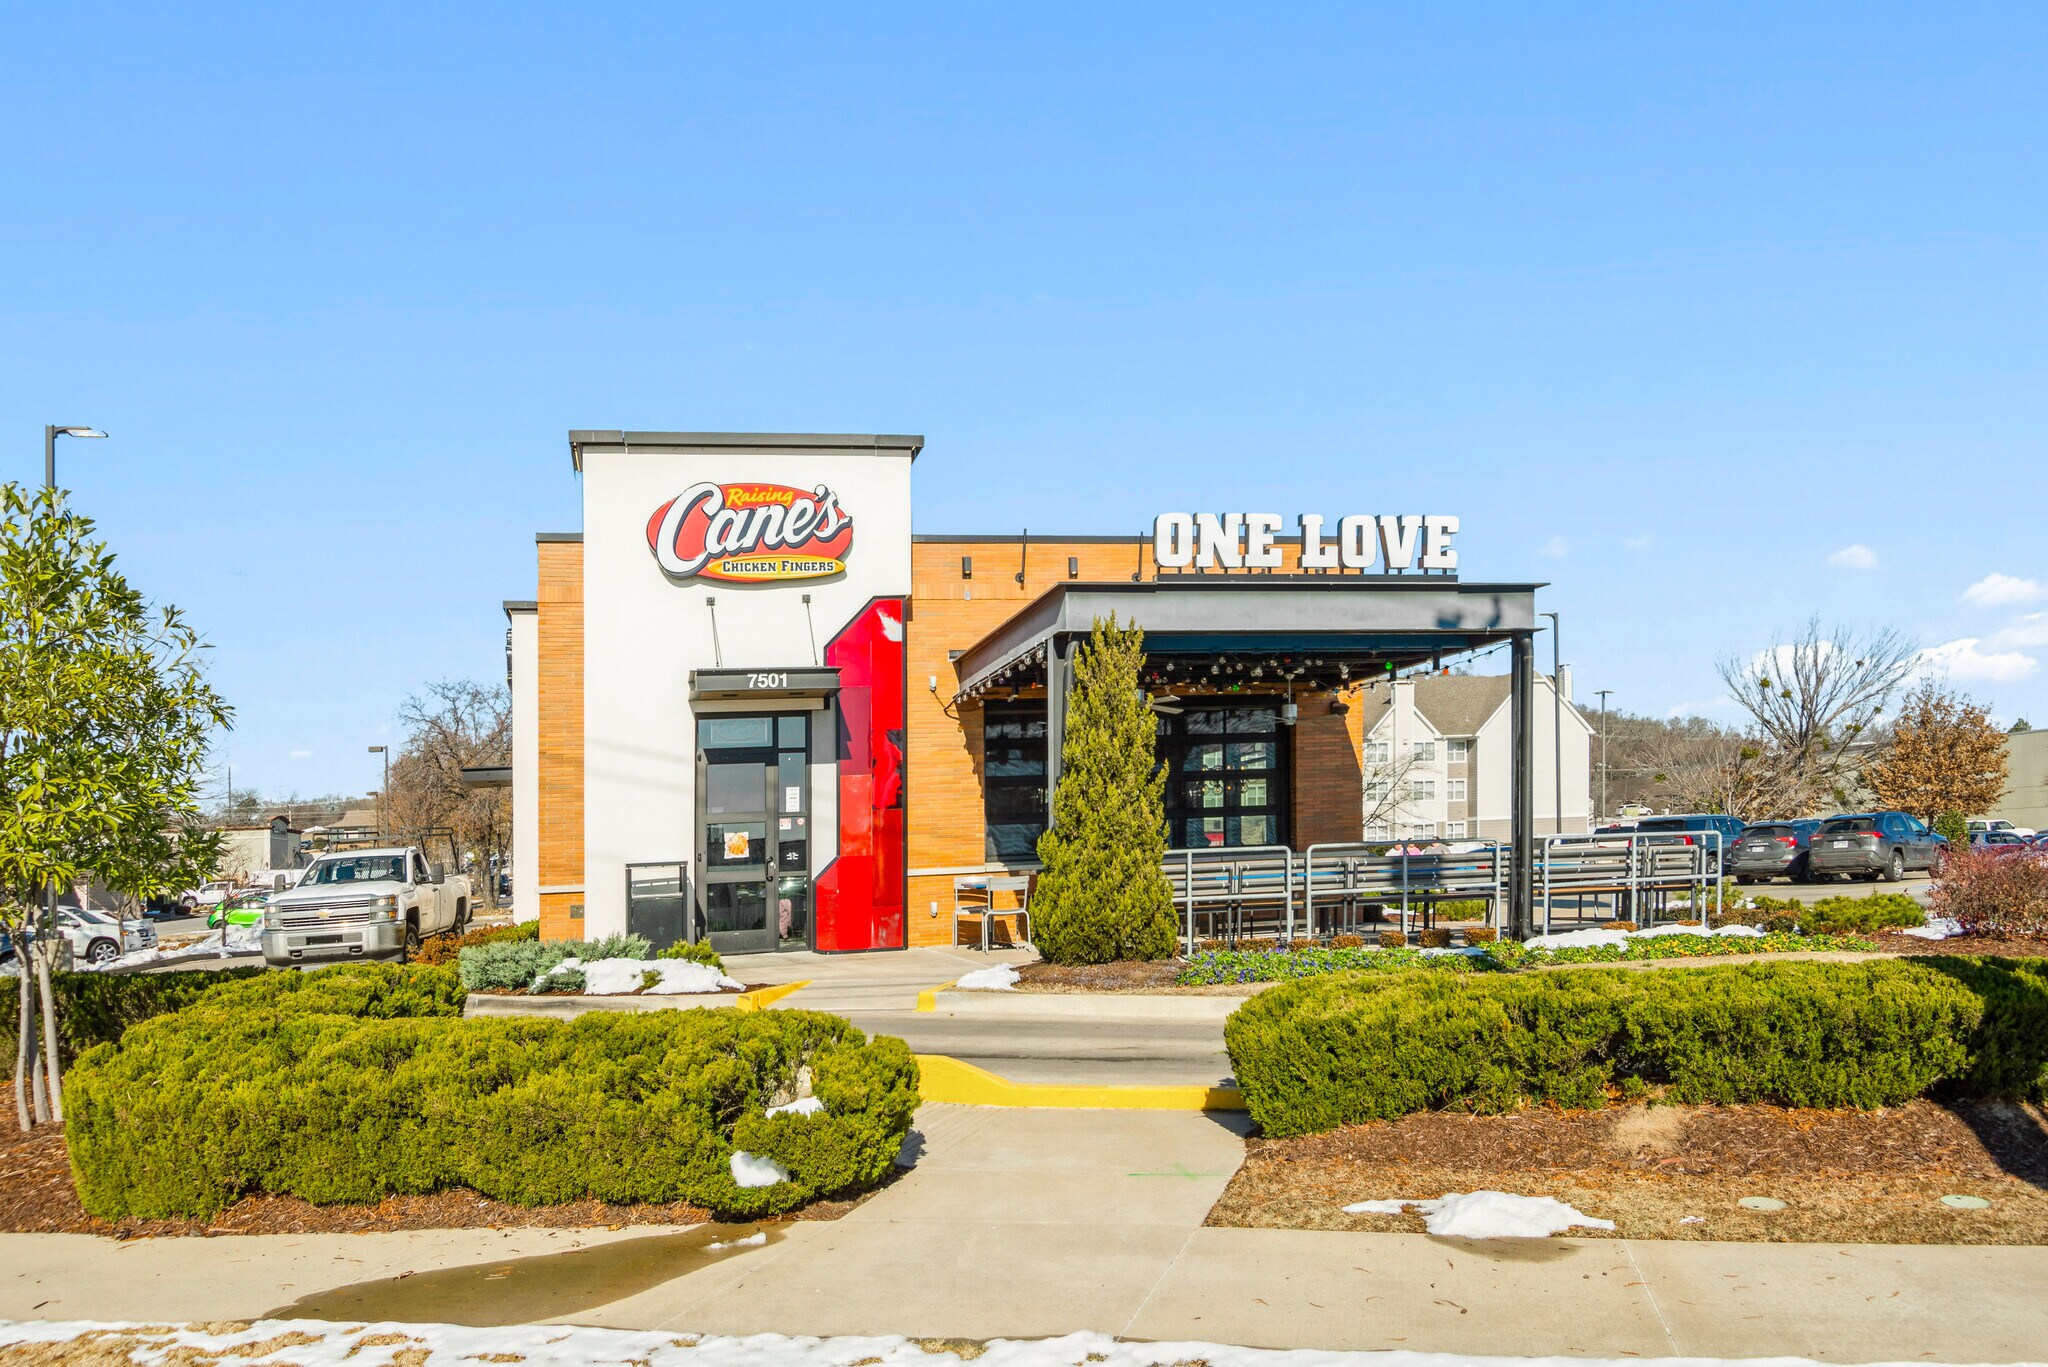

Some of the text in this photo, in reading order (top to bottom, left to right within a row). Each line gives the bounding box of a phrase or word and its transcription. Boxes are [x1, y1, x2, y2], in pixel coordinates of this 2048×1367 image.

[726, 488, 794, 506] Raising
[656, 482, 853, 578] Cane's
[1153, 512, 1460, 569] ONE LOVE
[722, 560, 834, 572] CHICKEN FINGERS
[747, 673, 788, 688] 7501
